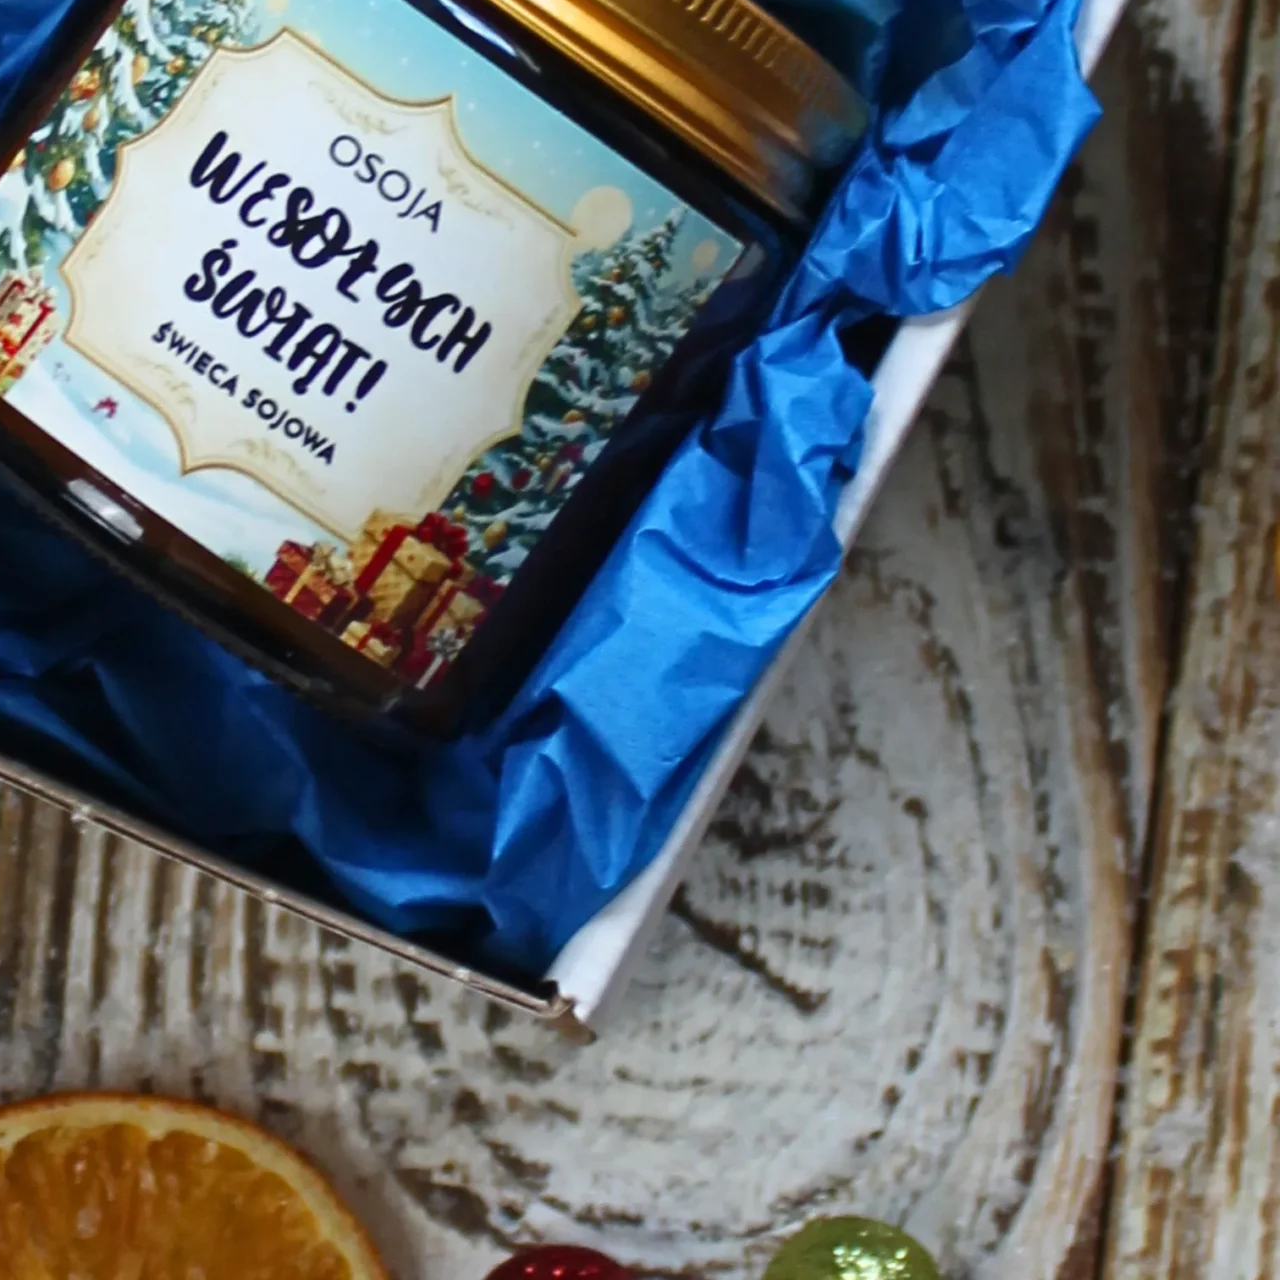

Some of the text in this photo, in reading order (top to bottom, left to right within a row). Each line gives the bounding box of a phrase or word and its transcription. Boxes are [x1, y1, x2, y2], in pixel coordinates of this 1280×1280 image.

[189, 131, 493, 375] WESOŁYCH
[329, 134, 444, 233] OSOJA
[151, 321, 337, 466] ŚWIECA SOJOWA
[183, 238, 388, 414] ŚWIĄT!
